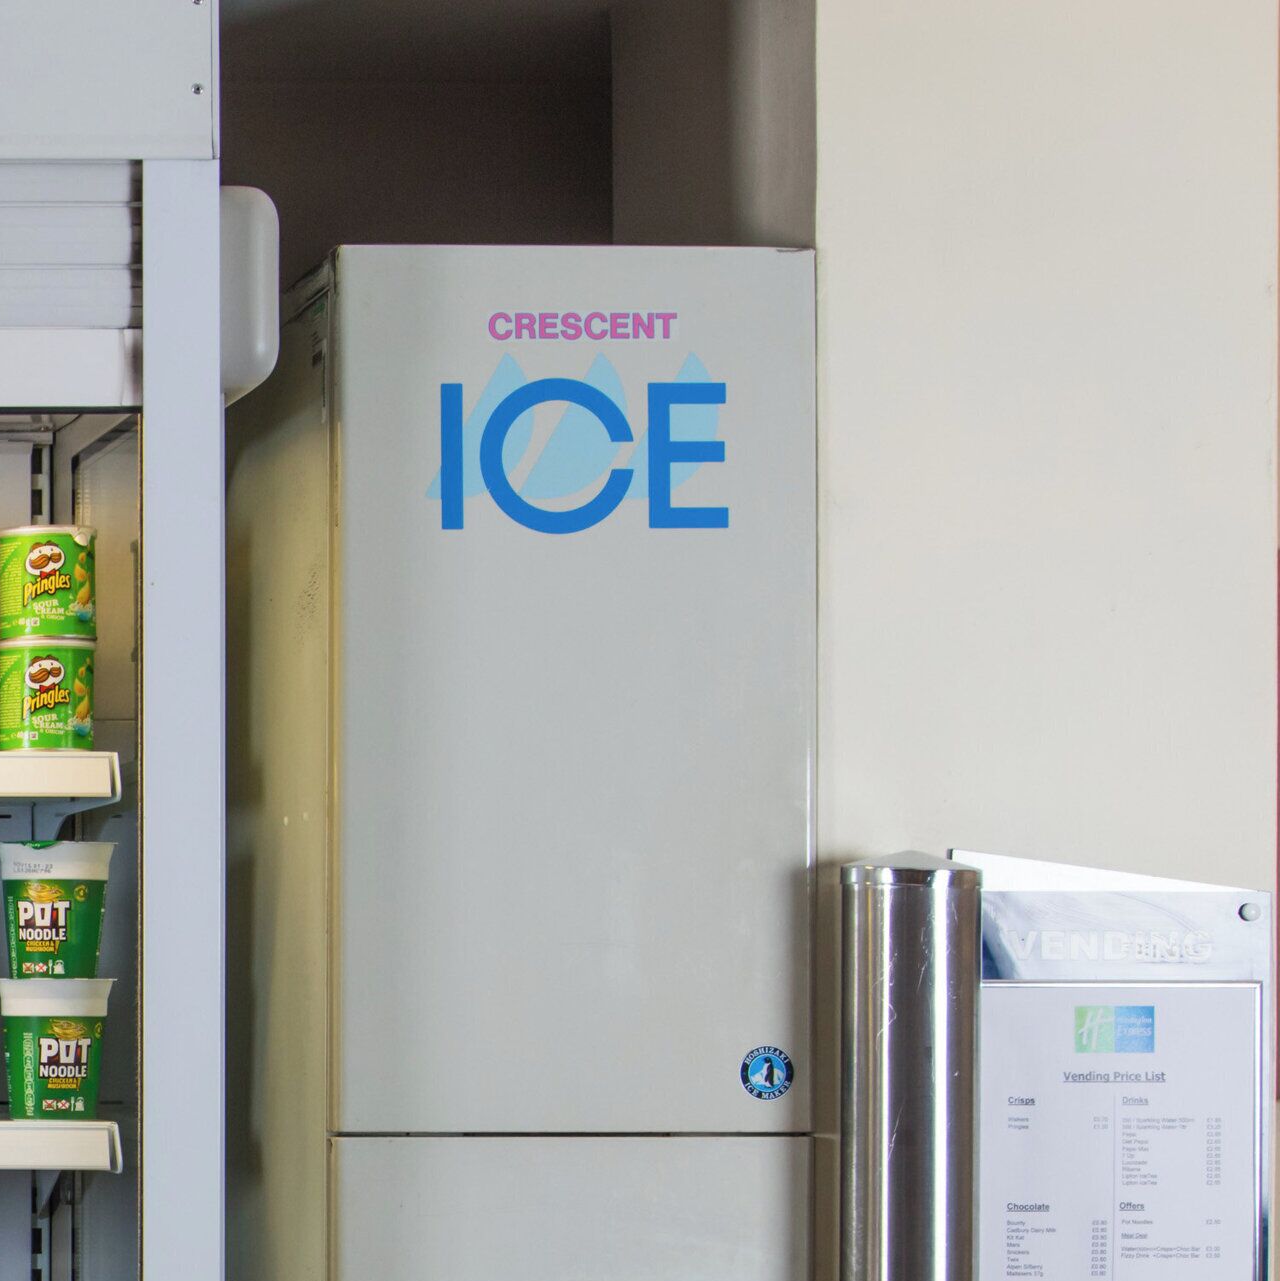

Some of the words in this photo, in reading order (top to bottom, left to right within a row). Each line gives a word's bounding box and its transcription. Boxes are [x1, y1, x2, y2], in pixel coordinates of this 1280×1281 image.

[487, 311, 678, 341] CRESCENT
[439, 377, 729, 535] ICE
[22, 573, 71, 607] Pringles
[22, 688, 71, 722] Pringles
[17, 901, 71, 927] POT
[19, 927, 67, 942] NOODLE
[1007, 929, 1213, 963] VENDING
[39, 1037, 91, 1064] POT
[744, 1047, 790, 1066] HOSHIZAKI
[40, 1064, 87, 1079] NOODLE
[1063, 1070, 1110, 1083] Vending
[1113, 1070, 1142, 1082] Price
[1145, 1070, 1167, 1082] List
[1007, 1096, 1036, 1106] Crisps
[1121, 1096, 1150, 1106] Drinks
[1006, 1202, 1050, 1213] Chocolate
[1119, 1201, 1146, 1211] Offers
